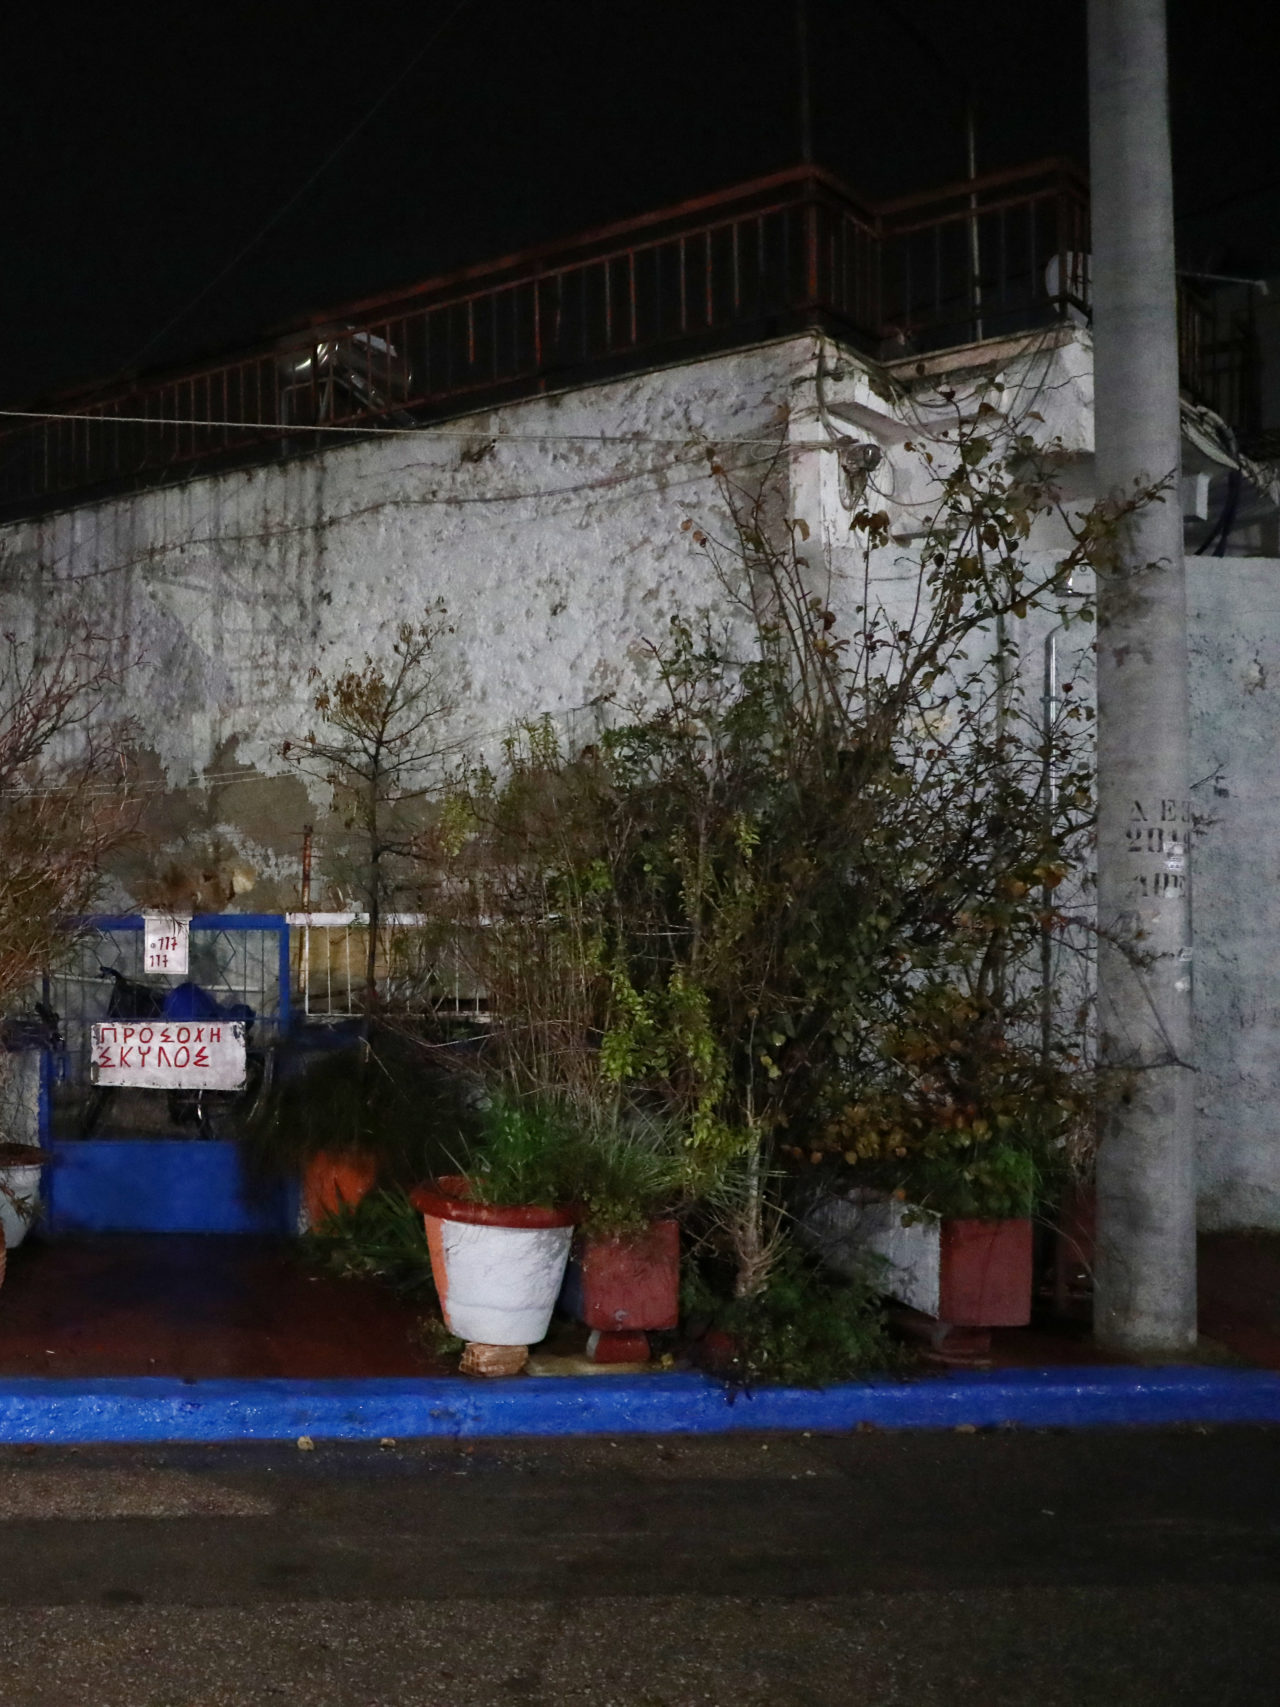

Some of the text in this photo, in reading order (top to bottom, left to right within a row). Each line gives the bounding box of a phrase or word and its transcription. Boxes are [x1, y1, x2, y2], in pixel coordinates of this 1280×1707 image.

[158, 936, 178, 951] 117
[150, 954, 168, 968] 117
[100, 1027, 221, 1044] ΠΡΟΣΟΧΗ
[98, 1045, 210, 1068] ΣΚΥΛΟΣ
